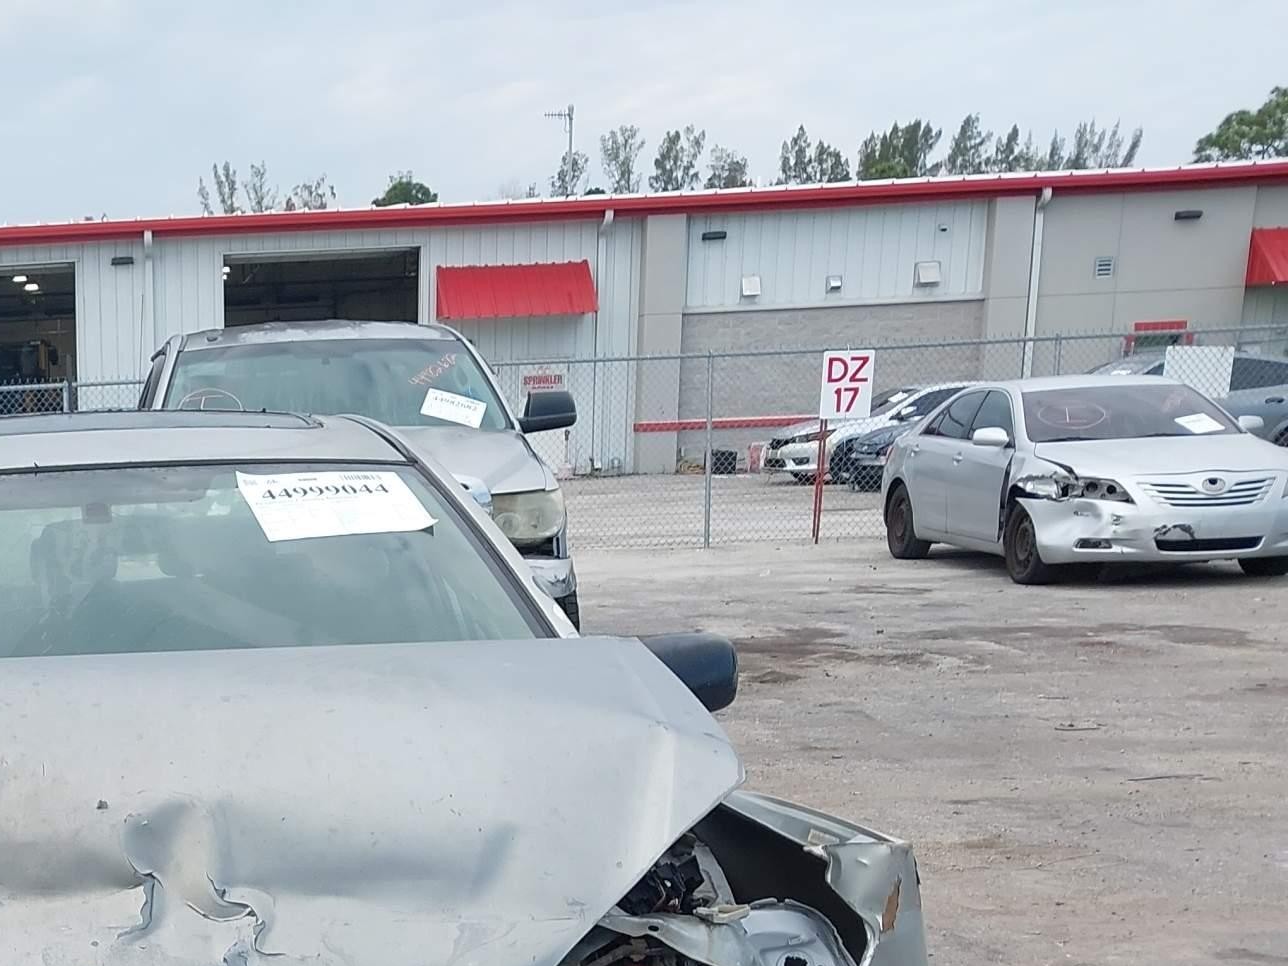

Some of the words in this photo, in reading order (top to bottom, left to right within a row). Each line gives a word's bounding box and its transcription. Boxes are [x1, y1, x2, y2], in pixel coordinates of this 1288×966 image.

[523, 375, 563, 385] SPRINKLER
[827, 356, 870, 383] DZ
[834, 387, 859, 412] 17
[262, 483, 389, 500] 44999044
